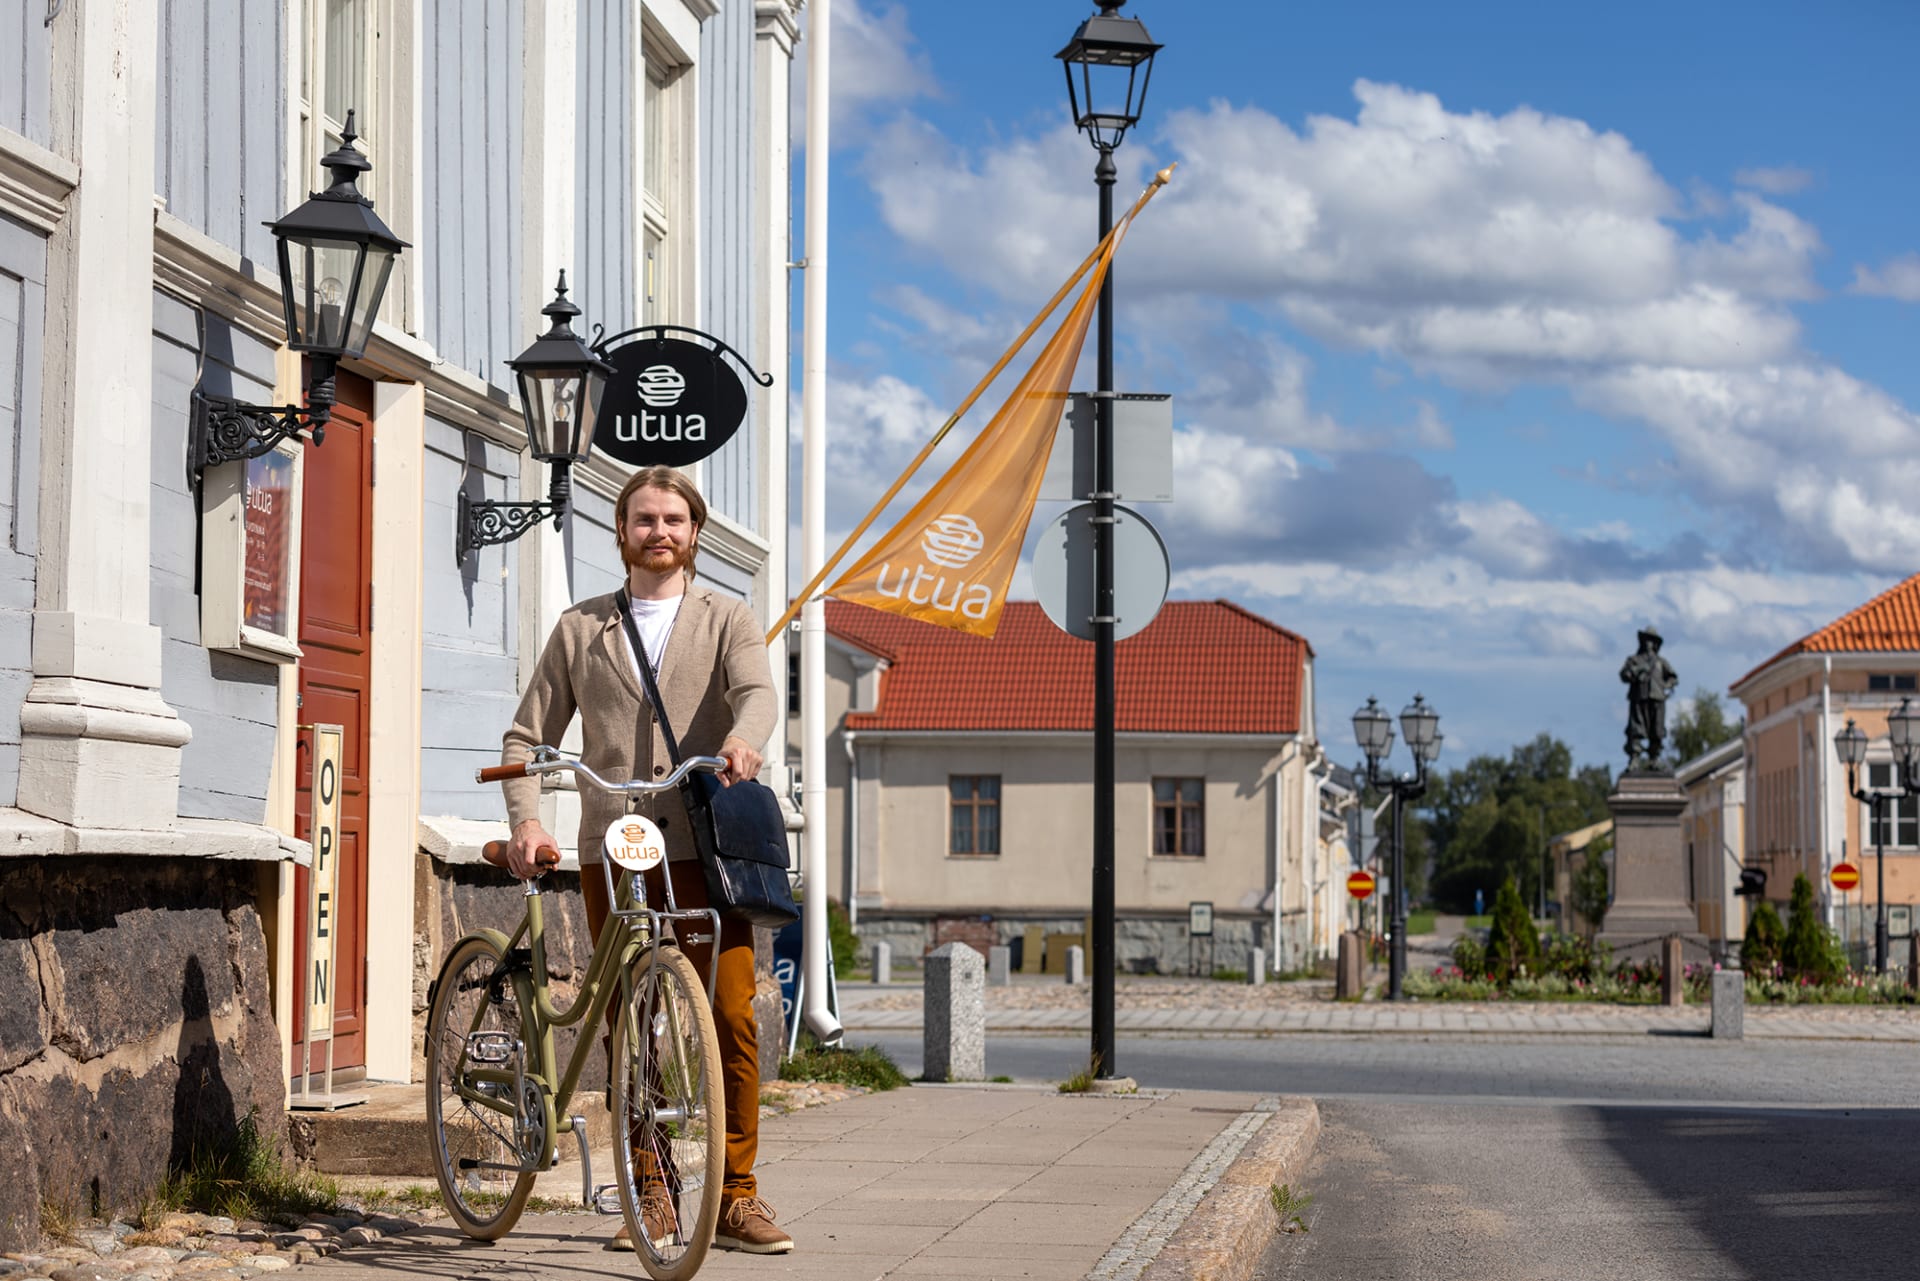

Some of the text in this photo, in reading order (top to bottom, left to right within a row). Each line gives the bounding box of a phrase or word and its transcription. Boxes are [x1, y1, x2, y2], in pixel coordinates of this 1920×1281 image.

[615, 409, 706, 442] utua
[252, 486, 272, 515] utua
[876, 562, 992, 620] utua
[613, 844, 660, 860] utua
[314, 758, 336, 1006] OPEN
